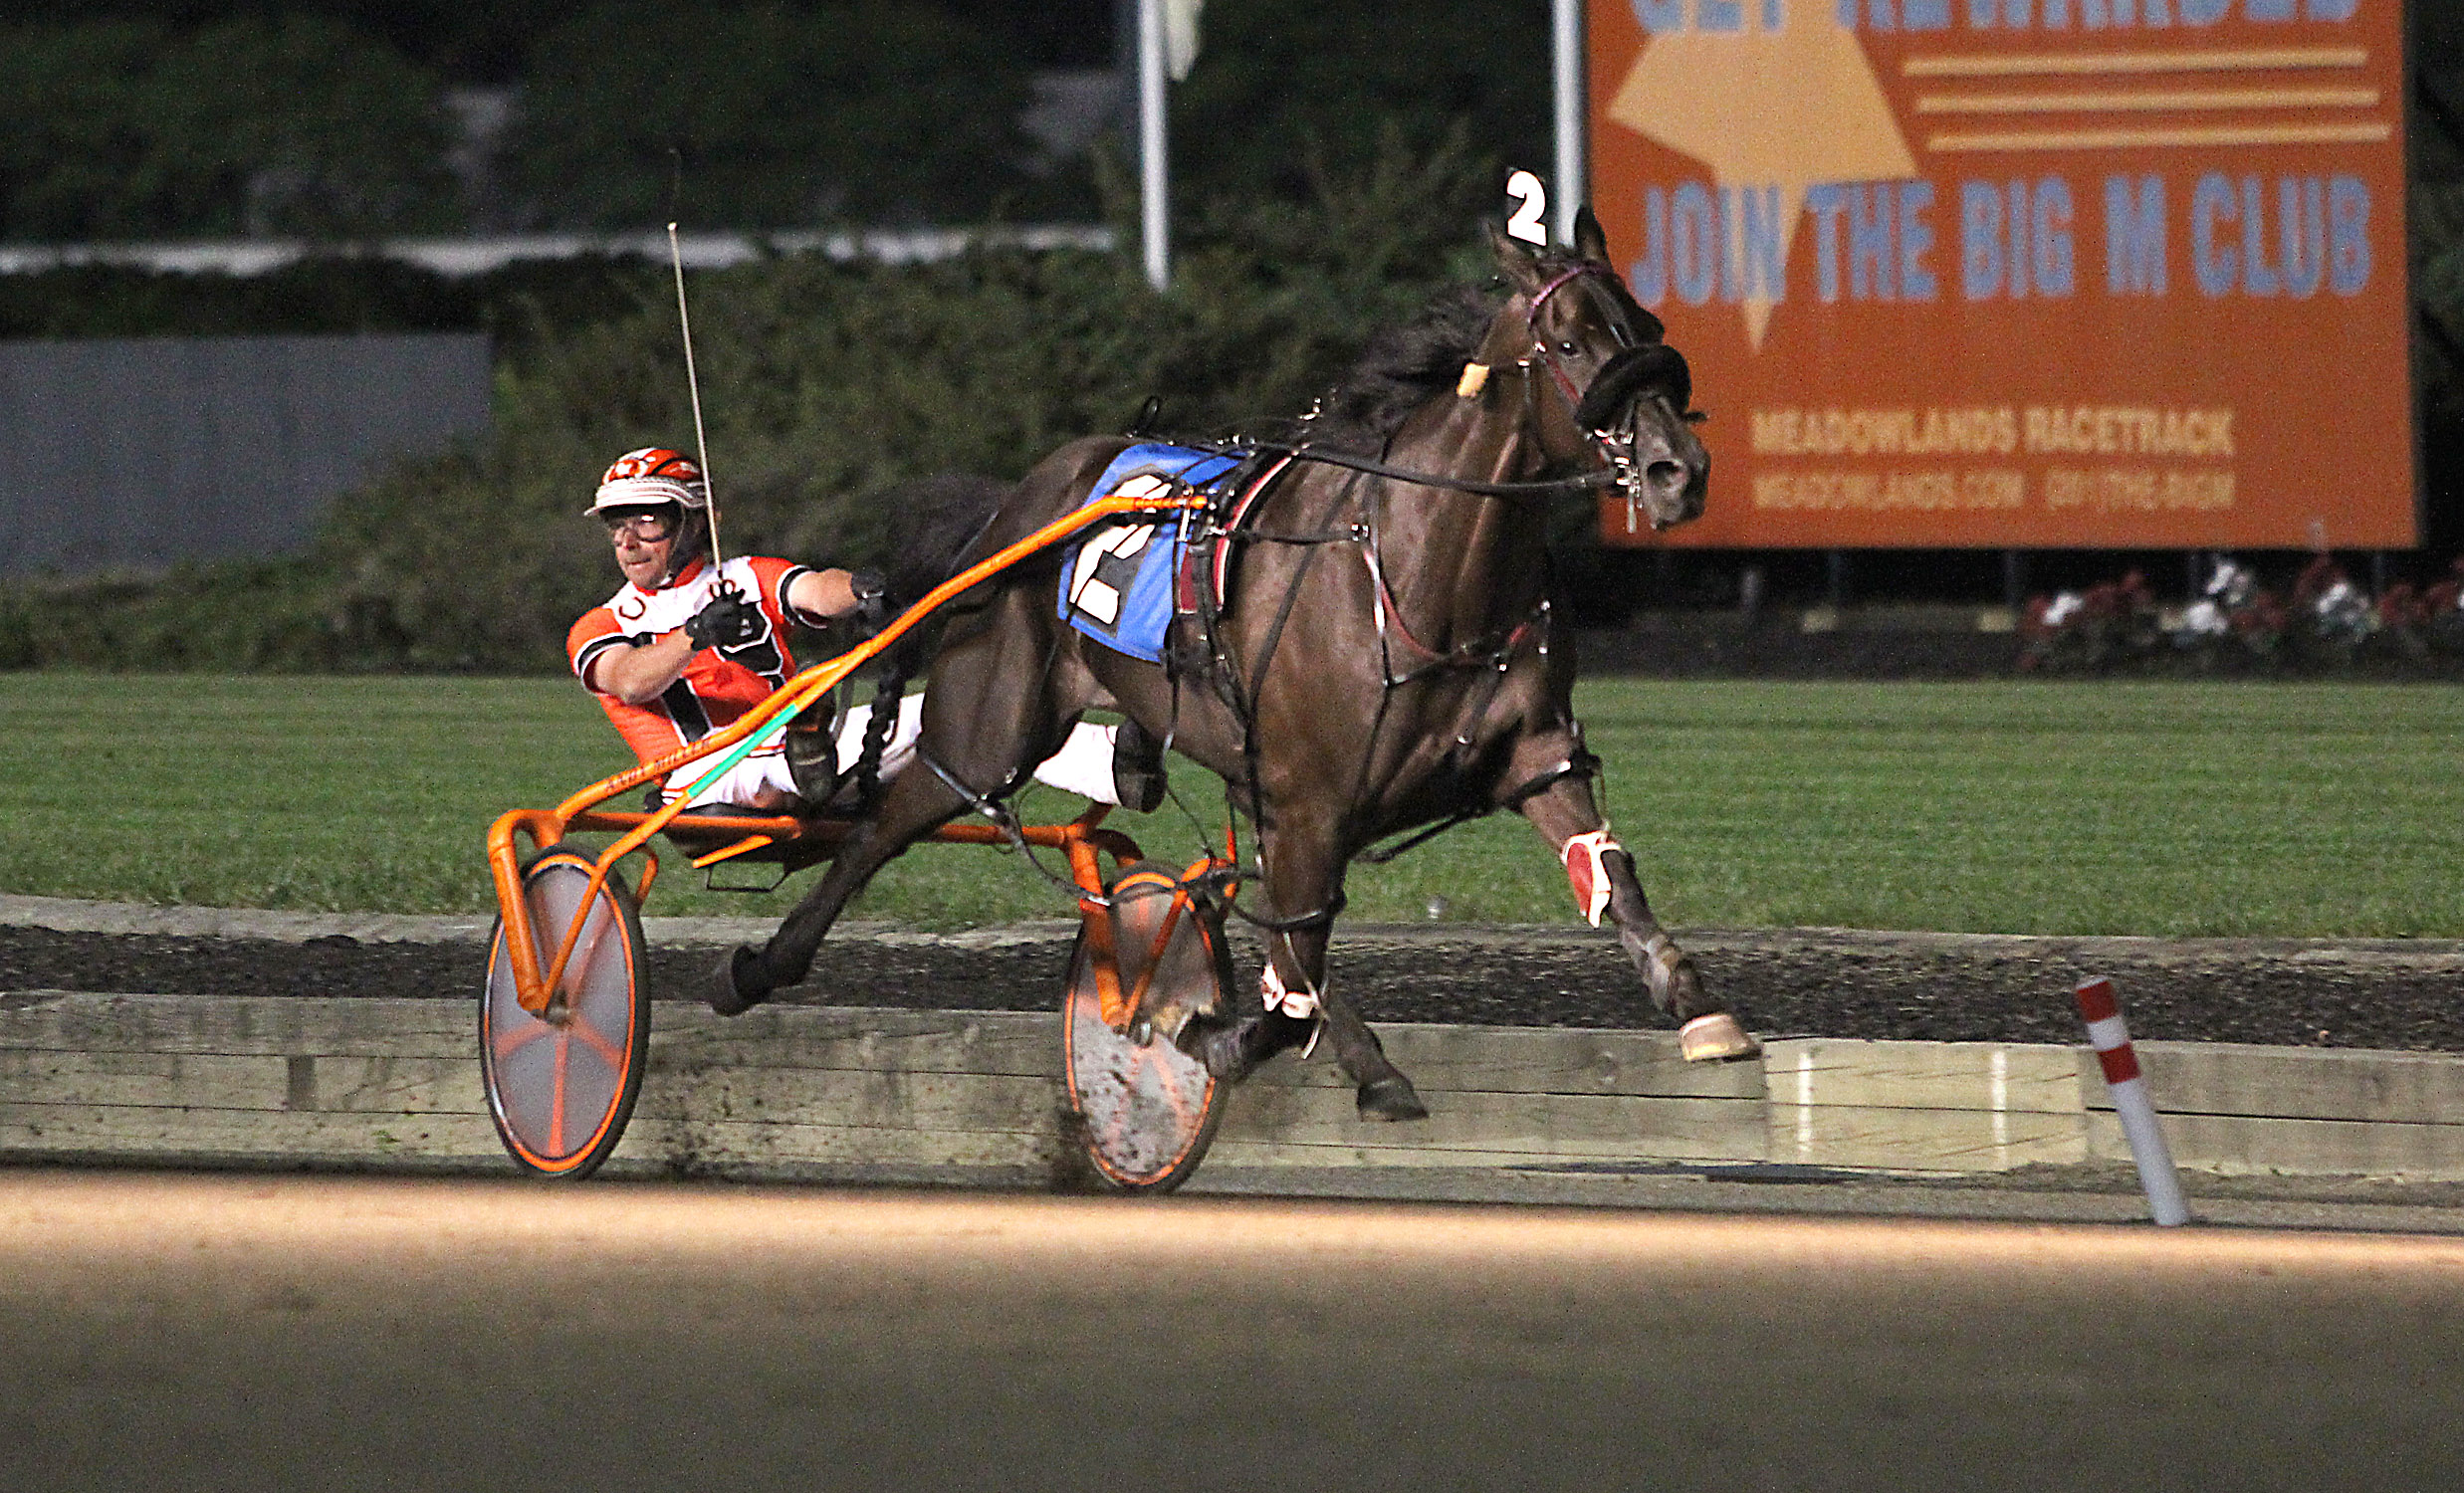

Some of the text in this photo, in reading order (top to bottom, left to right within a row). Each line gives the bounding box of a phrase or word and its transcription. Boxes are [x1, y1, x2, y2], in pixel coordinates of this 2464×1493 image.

[1506, 170, 1547, 247] 2
[1631, 170, 2370, 306] JOIN THE BIG M CLUB
[1753, 407, 2235, 455] MEADOWLANDS RACETRACK
[1069, 473, 1175, 626] 2
